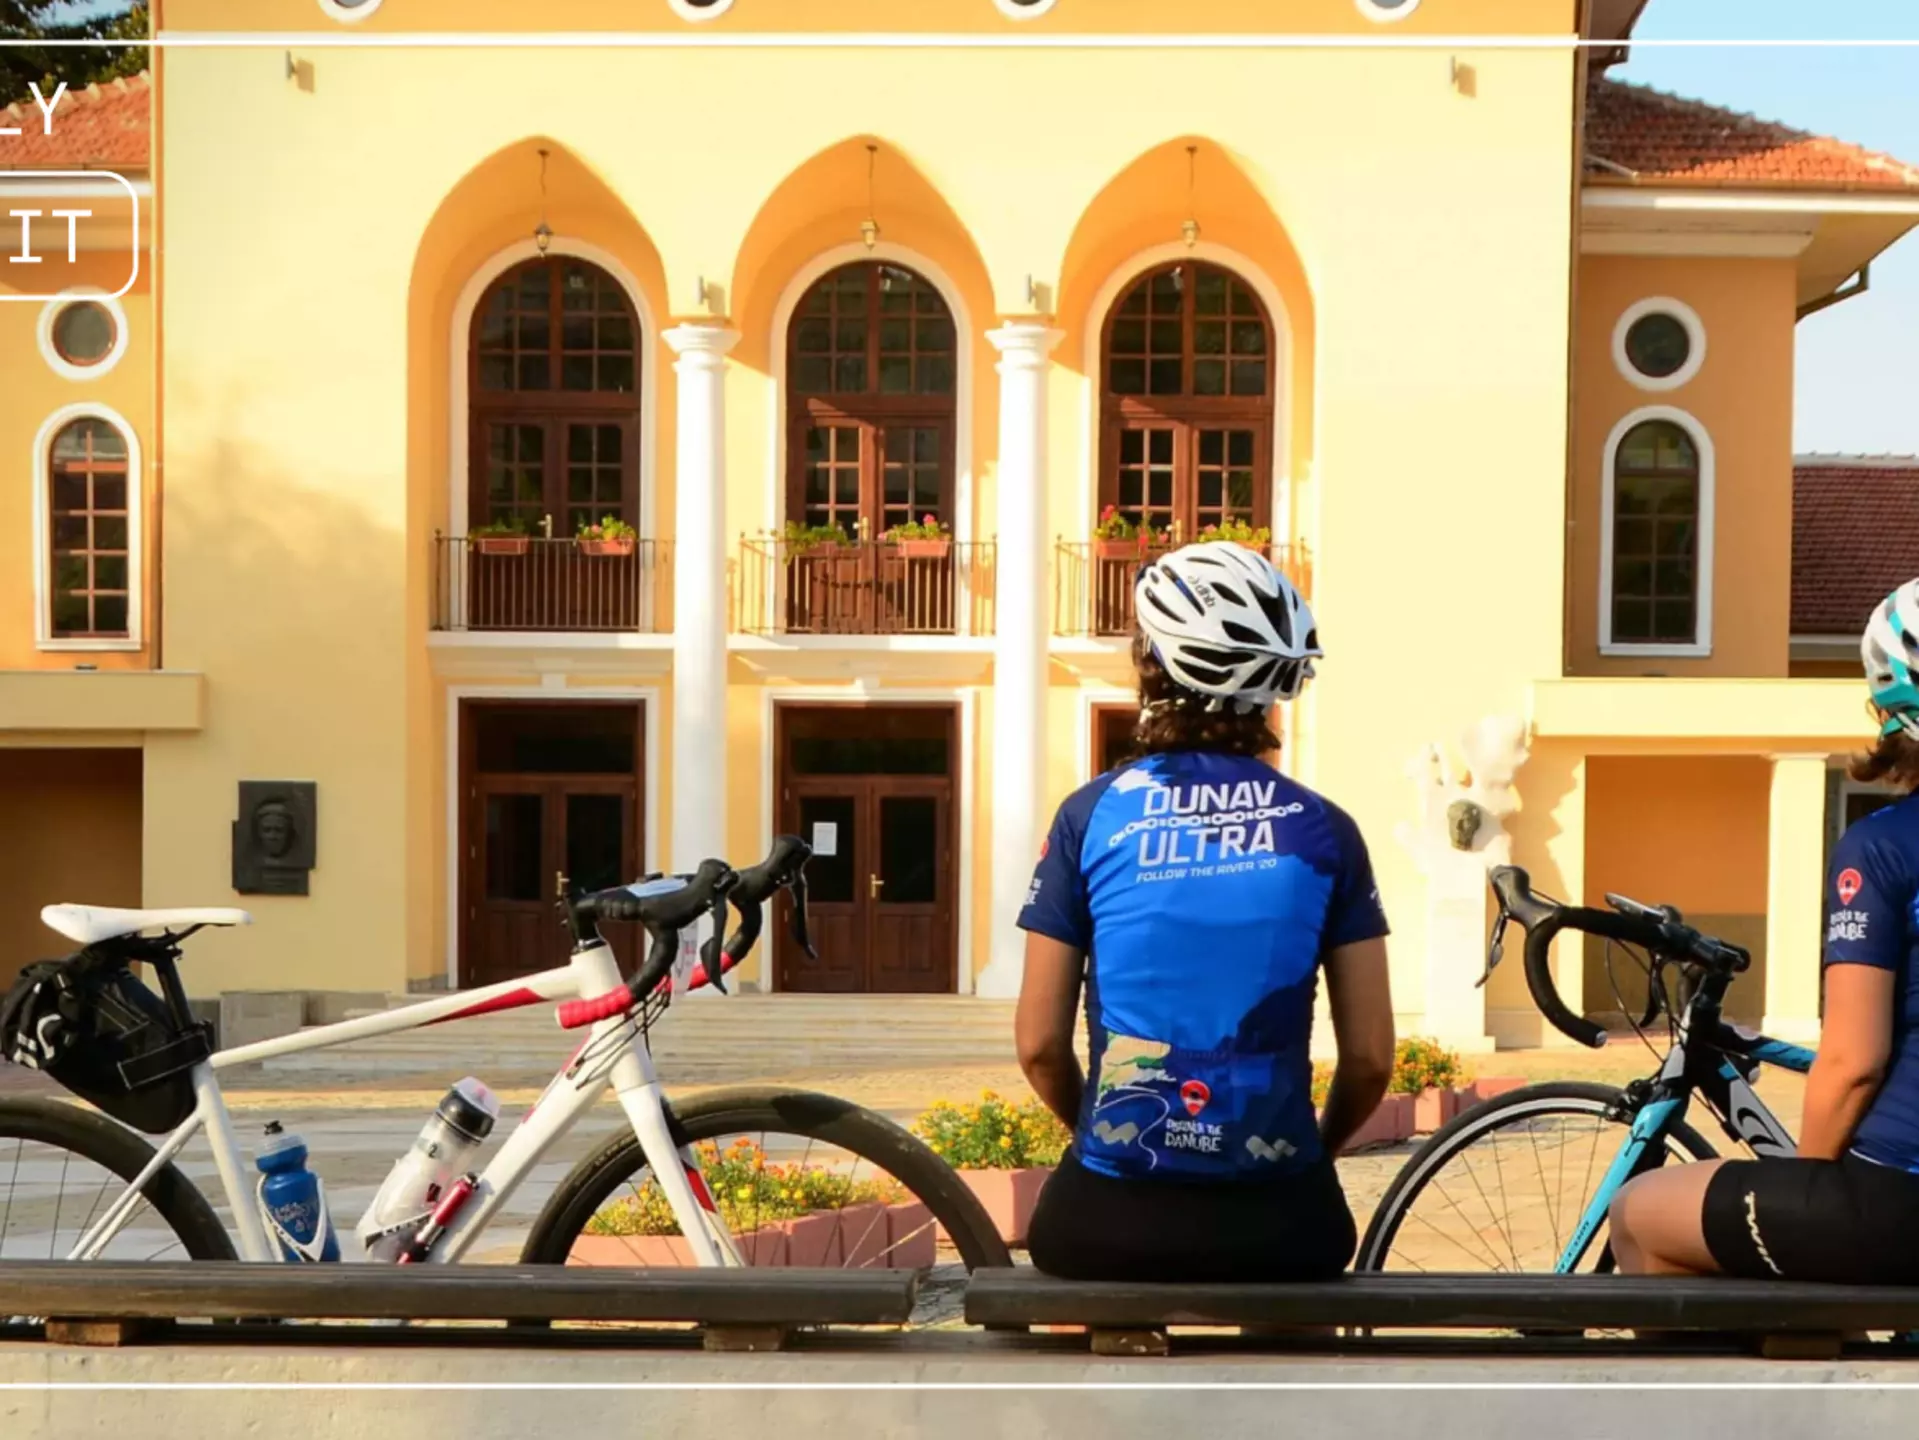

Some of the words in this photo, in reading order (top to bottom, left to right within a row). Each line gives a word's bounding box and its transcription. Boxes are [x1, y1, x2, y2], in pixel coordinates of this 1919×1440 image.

[1143, 780, 1276, 816] DUNAV
[1138, 820, 1275, 867] ULTRA
[1136, 867, 1187, 883] FOLLOW
[1190, 865, 1214, 877] THE
[1216, 861, 1254, 876] RIVER
[1164, 1131, 1222, 1153] DANUBE
